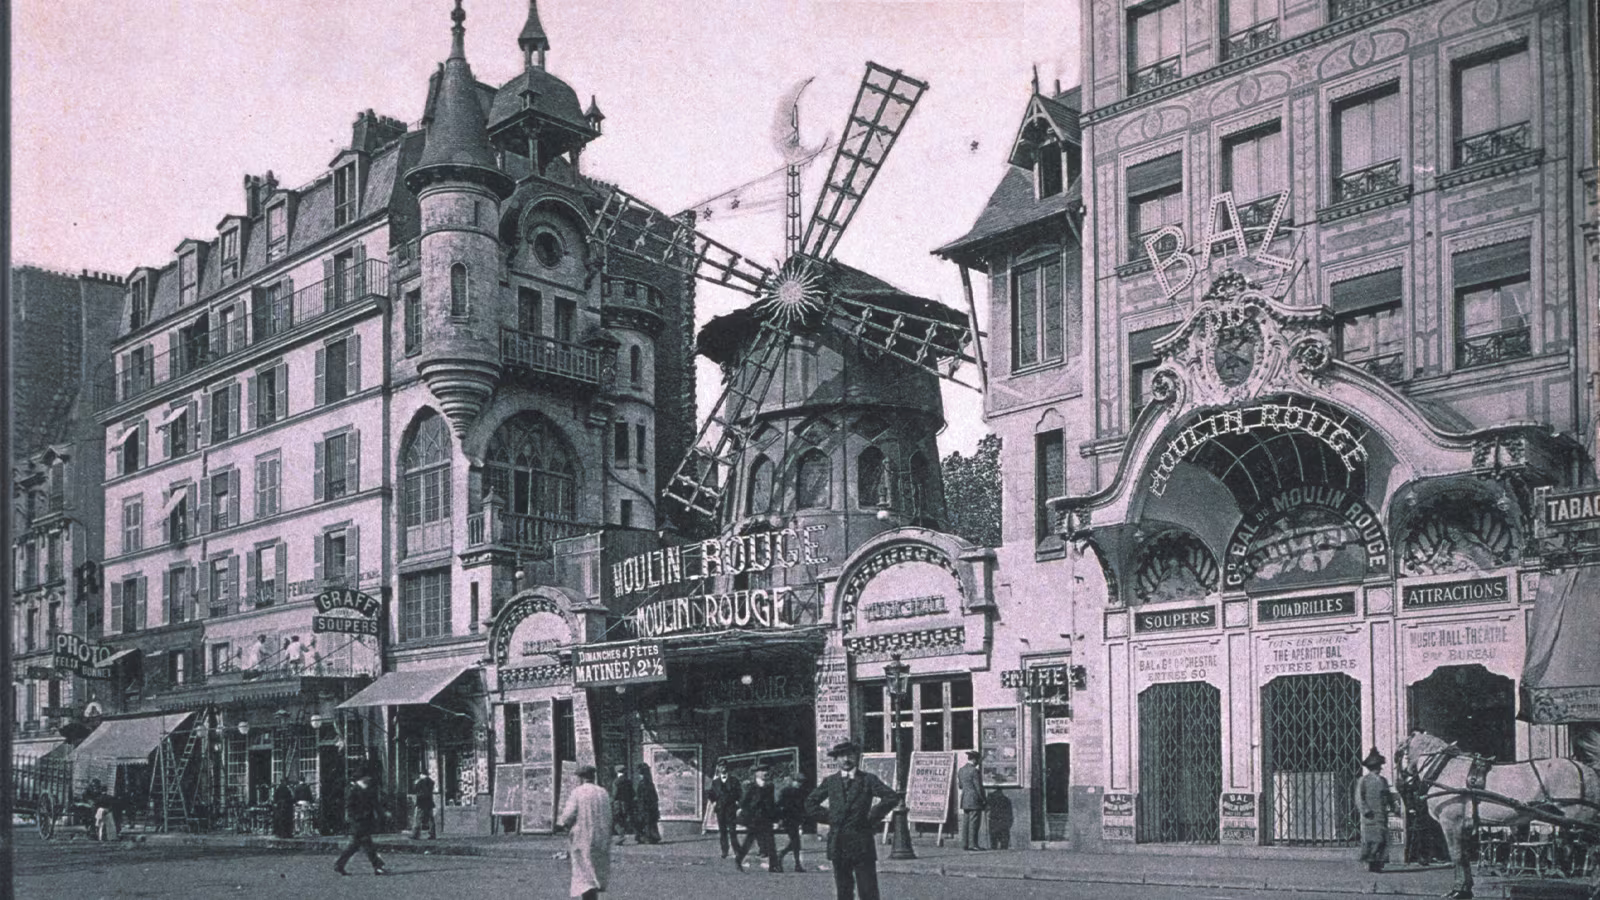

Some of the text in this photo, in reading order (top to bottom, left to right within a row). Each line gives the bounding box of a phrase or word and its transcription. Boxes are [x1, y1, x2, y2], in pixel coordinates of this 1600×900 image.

[1145, 190, 1296, 299] BAL
[1150, 403, 1369, 498] MOULIN ROUGE
[1230, 522, 1260, 557] BAL
[1273, 485, 1346, 515] MOULIN
[1345, 501, 1387, 568] ROUGE
[611, 523, 829, 598] MOULIN ROUGE
[319, 590, 377, 611] GRAFF
[1408, 582, 1504, 605] ATTRACTIONS
[635, 585, 795, 638] MOULIN ROUGE
[1272, 598, 1344, 619] QUADRILLES
[317, 618, 379, 634] SOUPERS
[1145, 611, 1210, 629] SOUPERS
[56, 634, 111, 663] PHOTO
[578, 650, 621, 664] DIMANCHES
[1325, 645, 1343, 659] BAL
[1448, 647, 1498, 661] BUREAU
[1317, 659, 1358, 672] LIBRE
